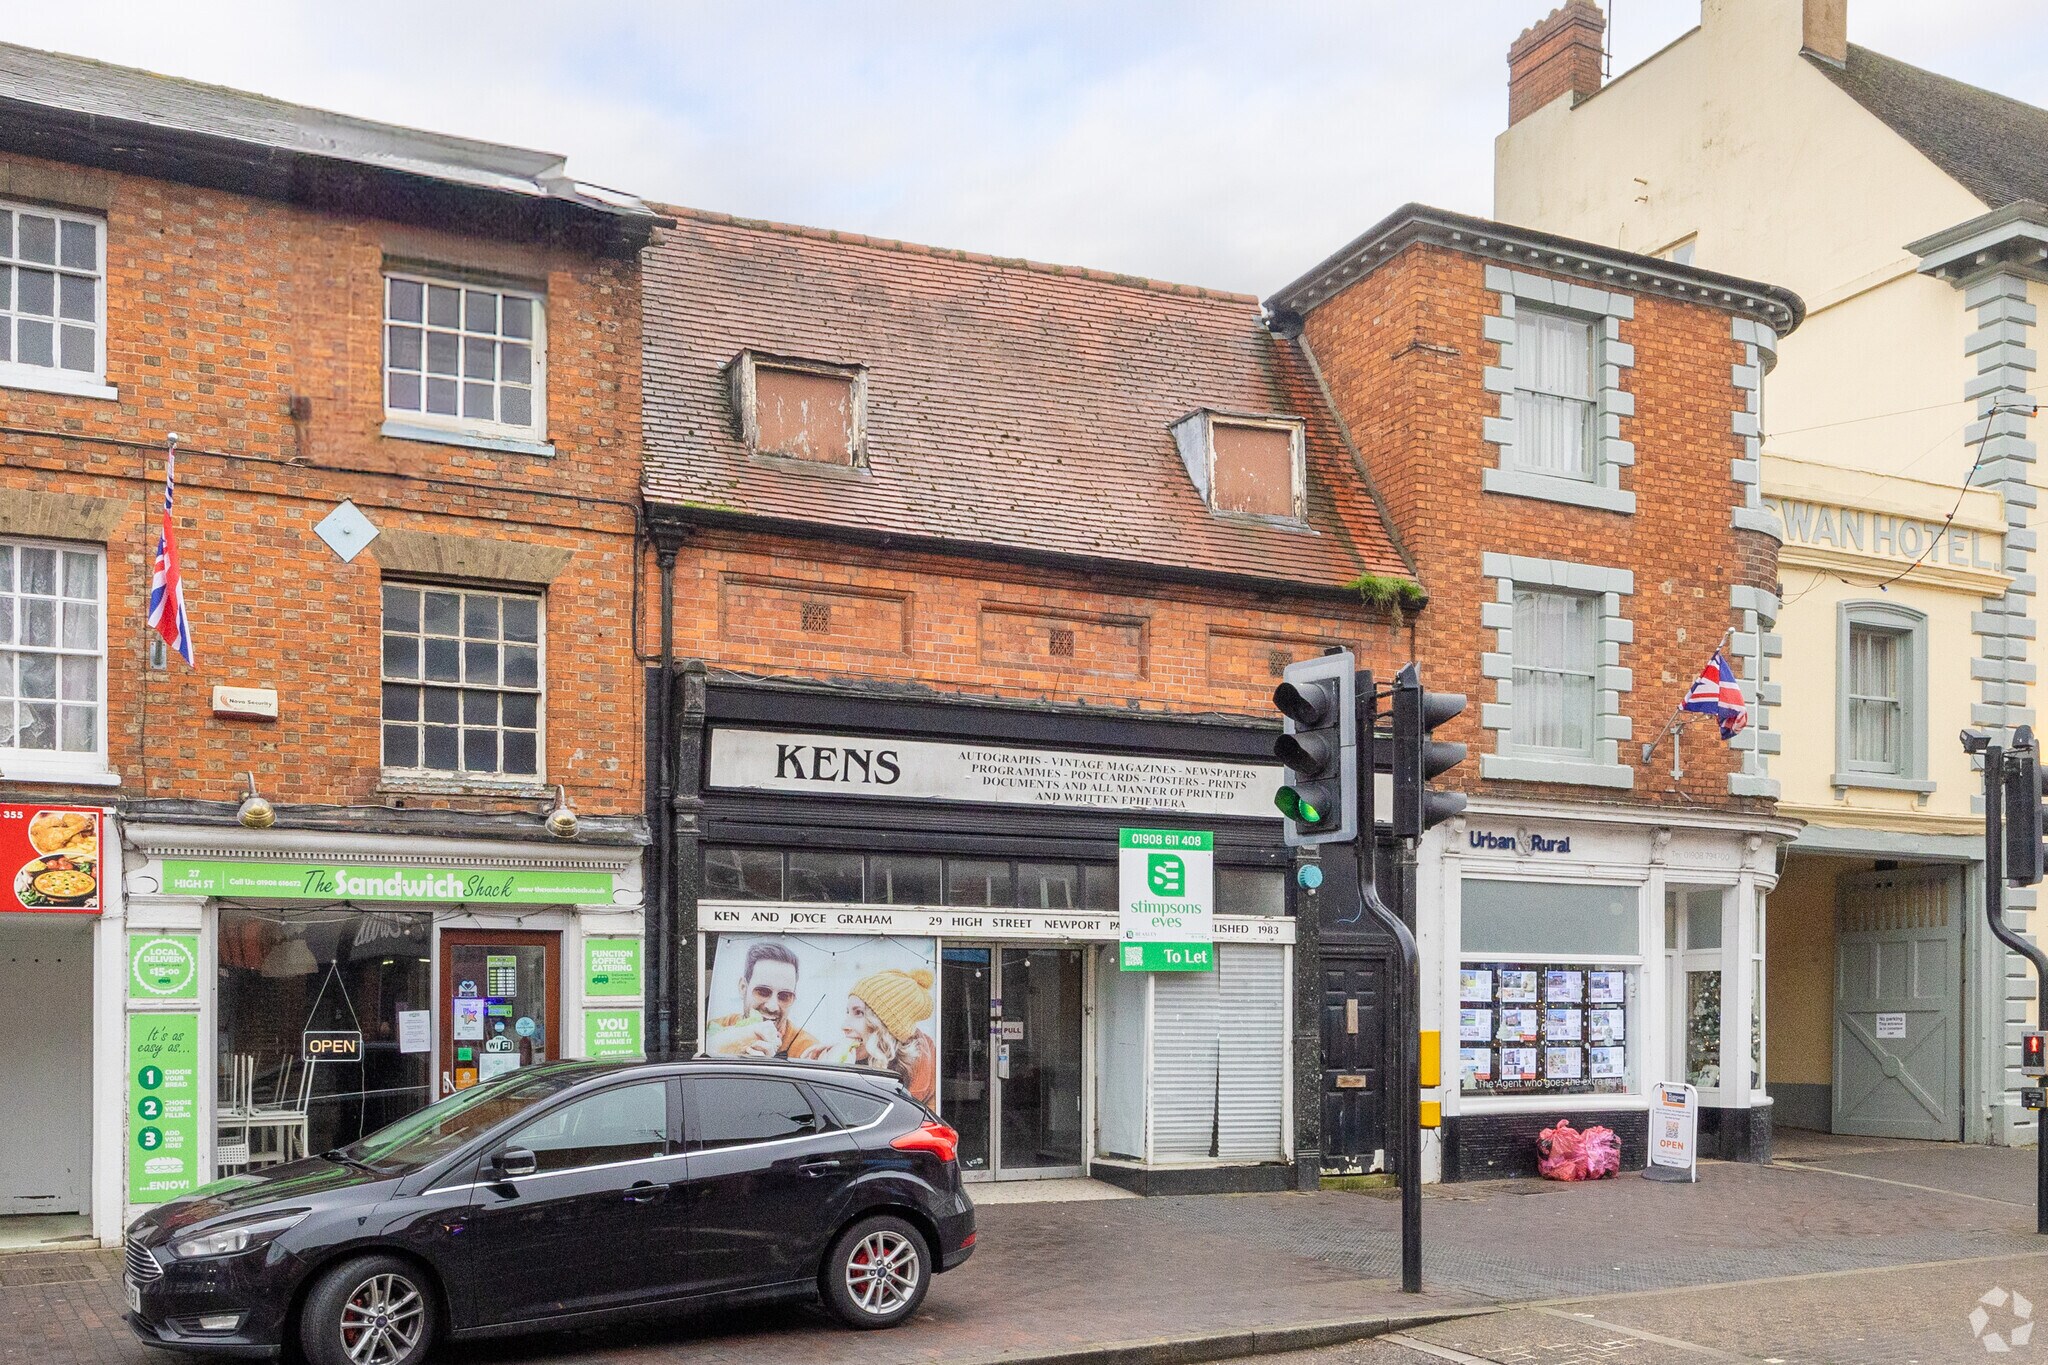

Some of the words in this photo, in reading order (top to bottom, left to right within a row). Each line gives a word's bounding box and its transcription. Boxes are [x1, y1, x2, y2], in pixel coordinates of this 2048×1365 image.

[1764, 500, 1865, 551] WAN
[247, 699, 273, 708] Security
[775, 743, 901, 785] KENS
[958, 751, 1041, 765] AUTOGRAPHS
[1051, 757, 1103, 770] VINTAGE
[1106, 761, 1176, 774] MAGAZINES
[1185, 766, 1257, 779] NEWSPAPERS
[971, 764, 1061, 778] PROGRAMMES
[1070, 770, 1140, 783] POSTCARDS
[1149, 775, 1199, 786] POSTERS
[1208, 779, 1247, 789] PRINTS
[982, 776, 1060, 790] DOCUMENTS
[1062, 782, 1087, 791] AND
[1090, 783, 1113, 793] ALL
[1116, 784, 1167, 796] MANNER
[1169, 787, 1185, 797] OF
[1186, 788, 1234, 800] PRINTED
[1035, 792, 1061, 801] AND
[1064, 793, 1119, 804] WRITTEN
[1122, 796, 1186, 808] EPHEMERA
[3, 810, 24, 819] 355
[1131, 833, 1163, 845] 01908
[1165, 834, 1179, 846] 611
[1181, 835, 1202, 847] 408
[1469, 830, 1516, 849] Urban
[1531, 834, 1571, 853] Rural
[188, 869, 201, 878] 27
[174, 879, 201, 888] HIGH
[203, 879, 215, 889] ST
[303, 870, 334, 894] The
[334, 869, 464, 898] Sandwich
[463, 874, 515, 898] Shack
[1130, 900, 1202, 917] stimpsons
[713, 911, 740, 921] KEN
[750, 912, 780, 922] AND
[790, 912, 827, 924] JOYCE
[837, 913, 893, 924] GRAHAM
[928, 916, 943, 926] 29
[951, 917, 983, 927] HIGH
[992, 918, 1033, 928] STREET
[1044, 919, 1101, 930] NEWPORT
[1212, 923, 1250, 934] LISHED
[1258, 925, 1279, 935] 1983
[1151, 917, 1183, 928] eves
[143, 955, 186, 963] DELIVERY
[150, 948, 180, 956] LOCAL
[591, 949, 634, 958] FUNCTION
[1164, 949, 1182, 964] To
[1185, 949, 1208, 964] Let
[591, 964, 633, 972] CATERING
[597, 1018, 629, 1031] YOU
[147, 1026, 169, 1041] It's
[172, 1032, 185, 1041] as
[137, 1044, 163, 1059] easy
[309, 1040, 356, 1053] OPEN
[146, 1070, 154, 1085] 1
[1478, 1079, 1494, 1088] The
[1496, 1079, 1523, 1090] Agent
[1525, 1078, 1543, 1087] who
[1545, 1078, 1565, 1089] goes
[1567, 1077, 1581, 1086] the
[1582, 1077, 1602, 1086] extra
[144, 1100, 157, 1116] 2
[144, 1131, 156, 1147] 3
[1659, 1139, 1685, 1151] OPEN
